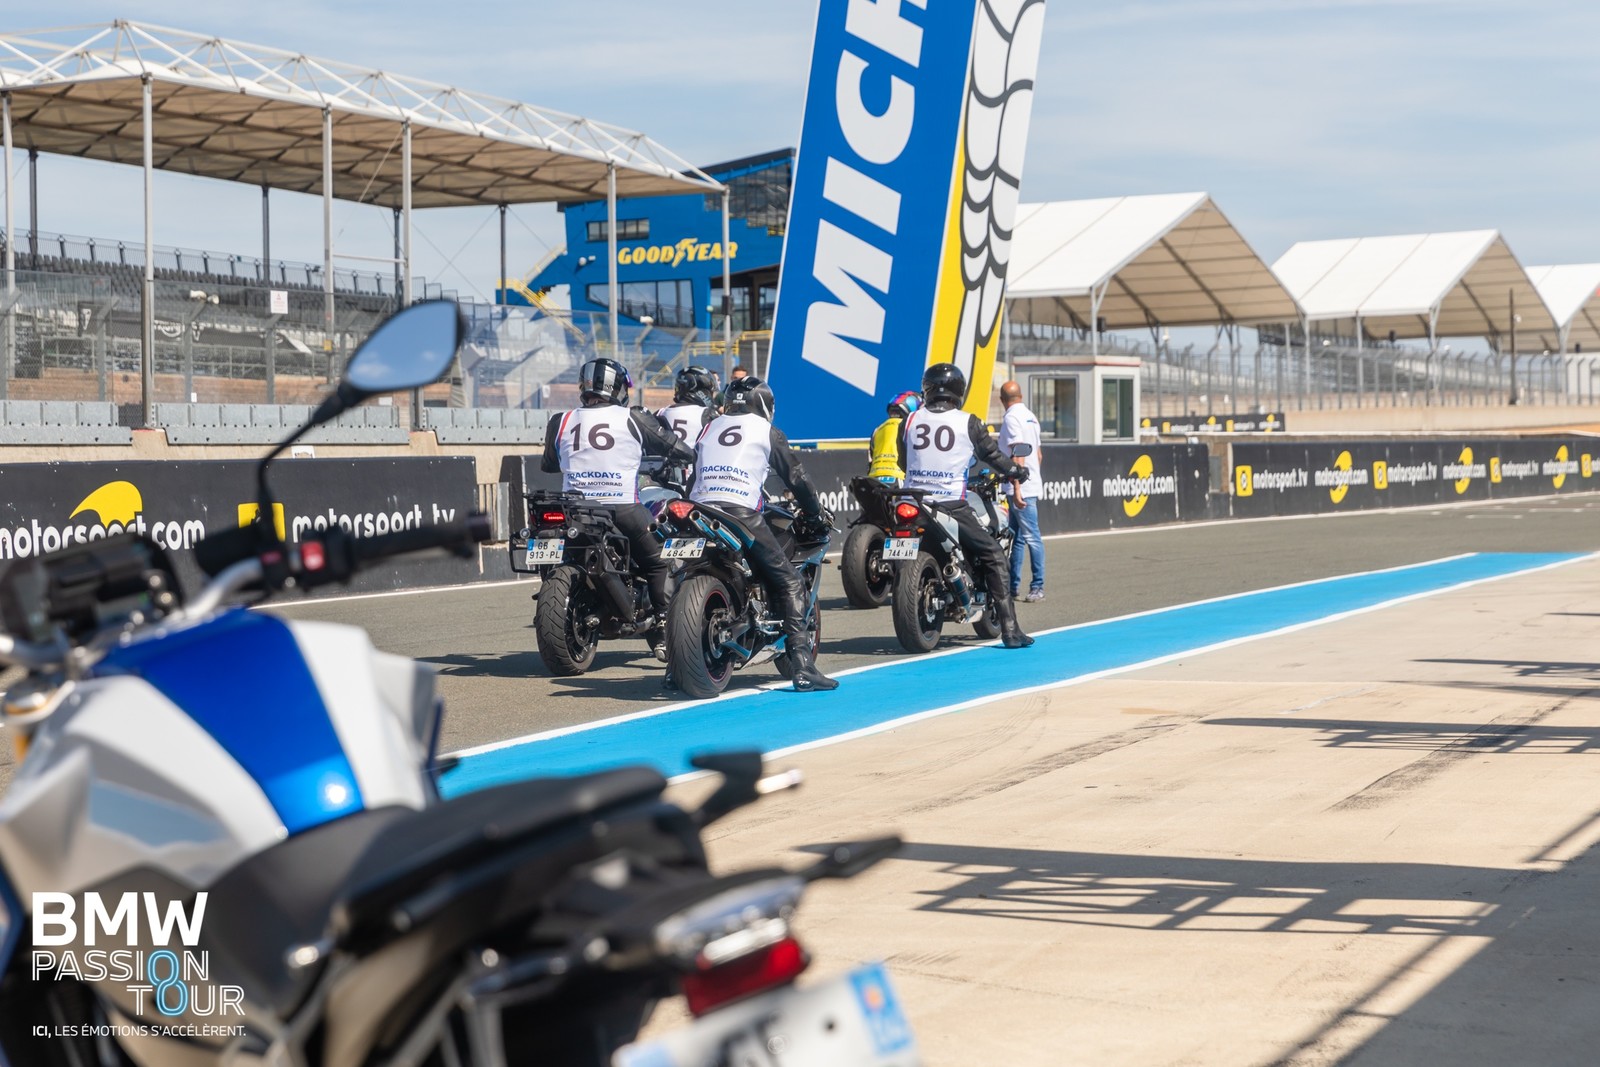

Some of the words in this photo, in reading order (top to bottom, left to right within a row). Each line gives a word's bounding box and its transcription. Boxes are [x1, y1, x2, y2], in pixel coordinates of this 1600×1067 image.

[618, 238, 738, 268] GOODYEAR
[570, 423, 615, 451] 16
[718, 425, 742, 446] 6
[913, 424, 955, 451] 30
[700, 465, 749, 479] RACKDAYS
[909, 470, 954, 478] TRACKDAYS
[1253, 468, 1308, 492] motorsport.tv
[1315, 467, 1368, 488] motorsport.com
[1388, 461, 1437, 486] motorsport.tv
[709, 486, 749, 496] MICHELIN
[1039, 476, 1092, 505] rsport.tv
[1103, 473, 1175, 500] motorsport.com
[292, 503, 455, 543] motorsporttv
[0, 515, 205, 560] otorstcom
